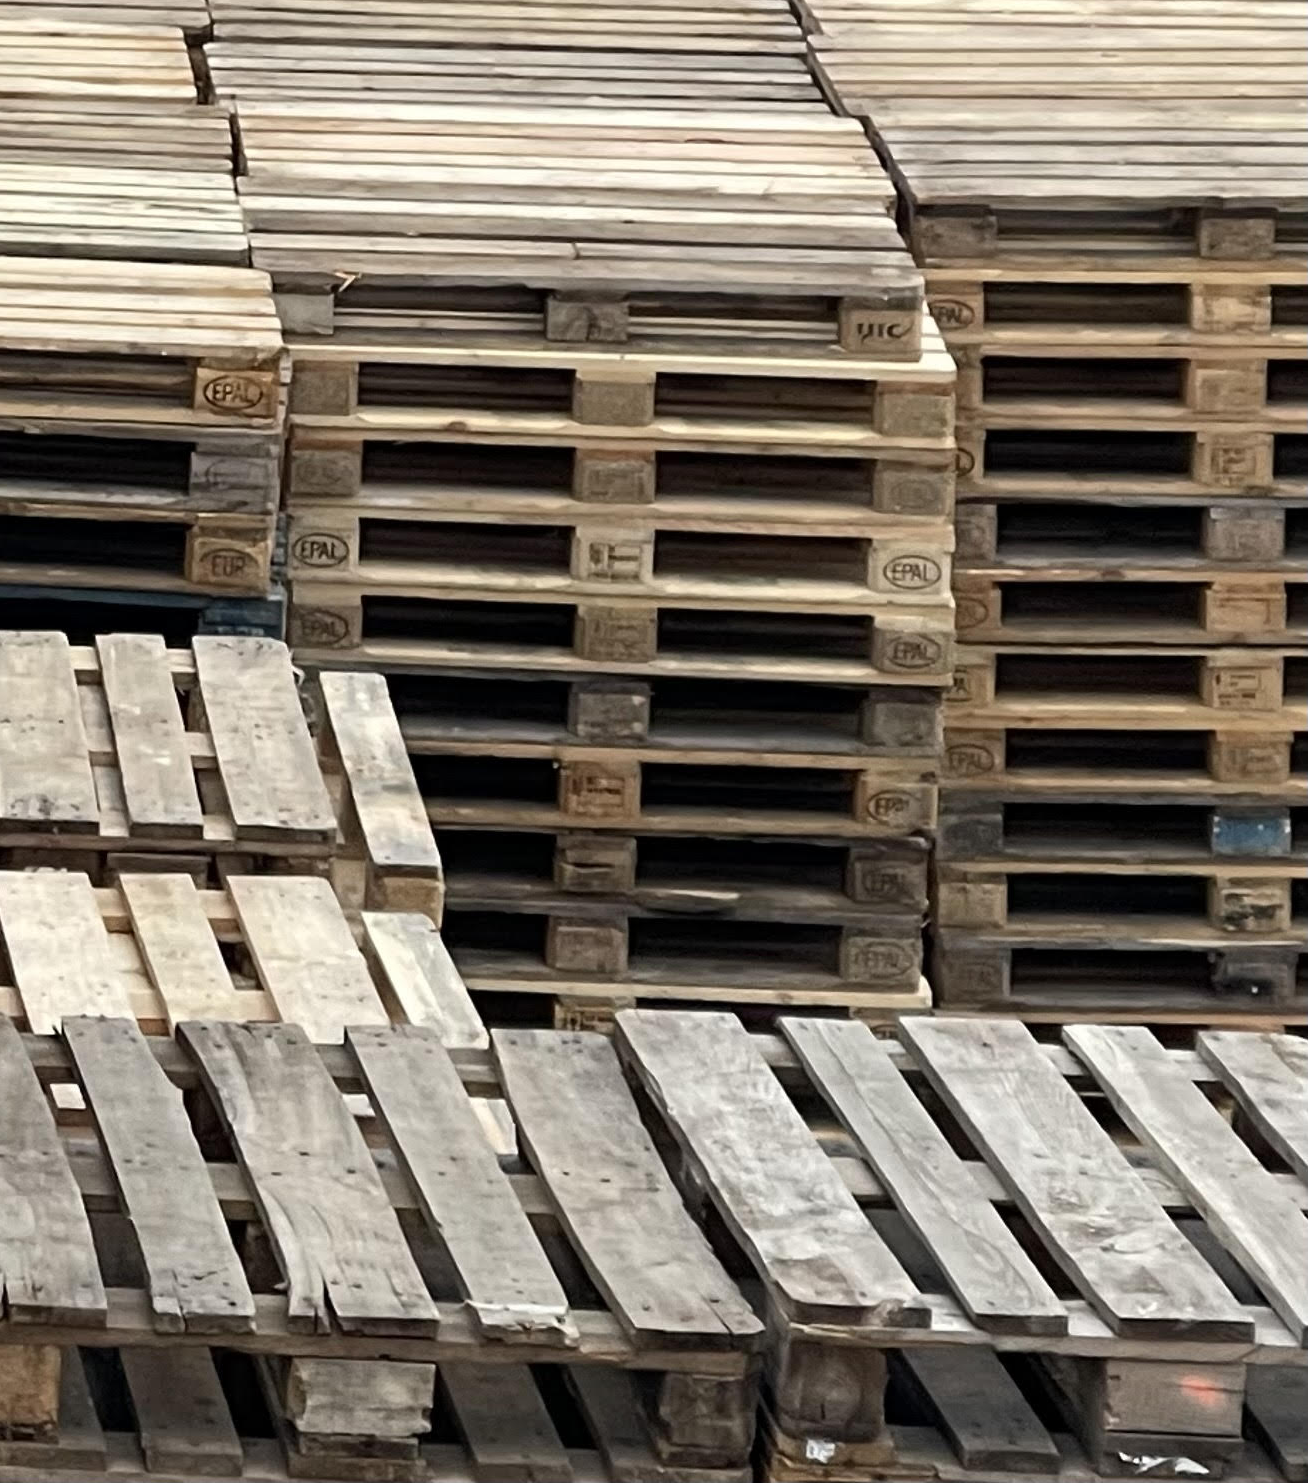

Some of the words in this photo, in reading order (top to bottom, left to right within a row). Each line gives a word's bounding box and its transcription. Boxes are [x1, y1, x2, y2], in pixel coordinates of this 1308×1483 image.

[212, 383, 256, 405] EPAL
[300, 539, 341, 562] EPAL
[891, 563, 933, 582] EPAL
